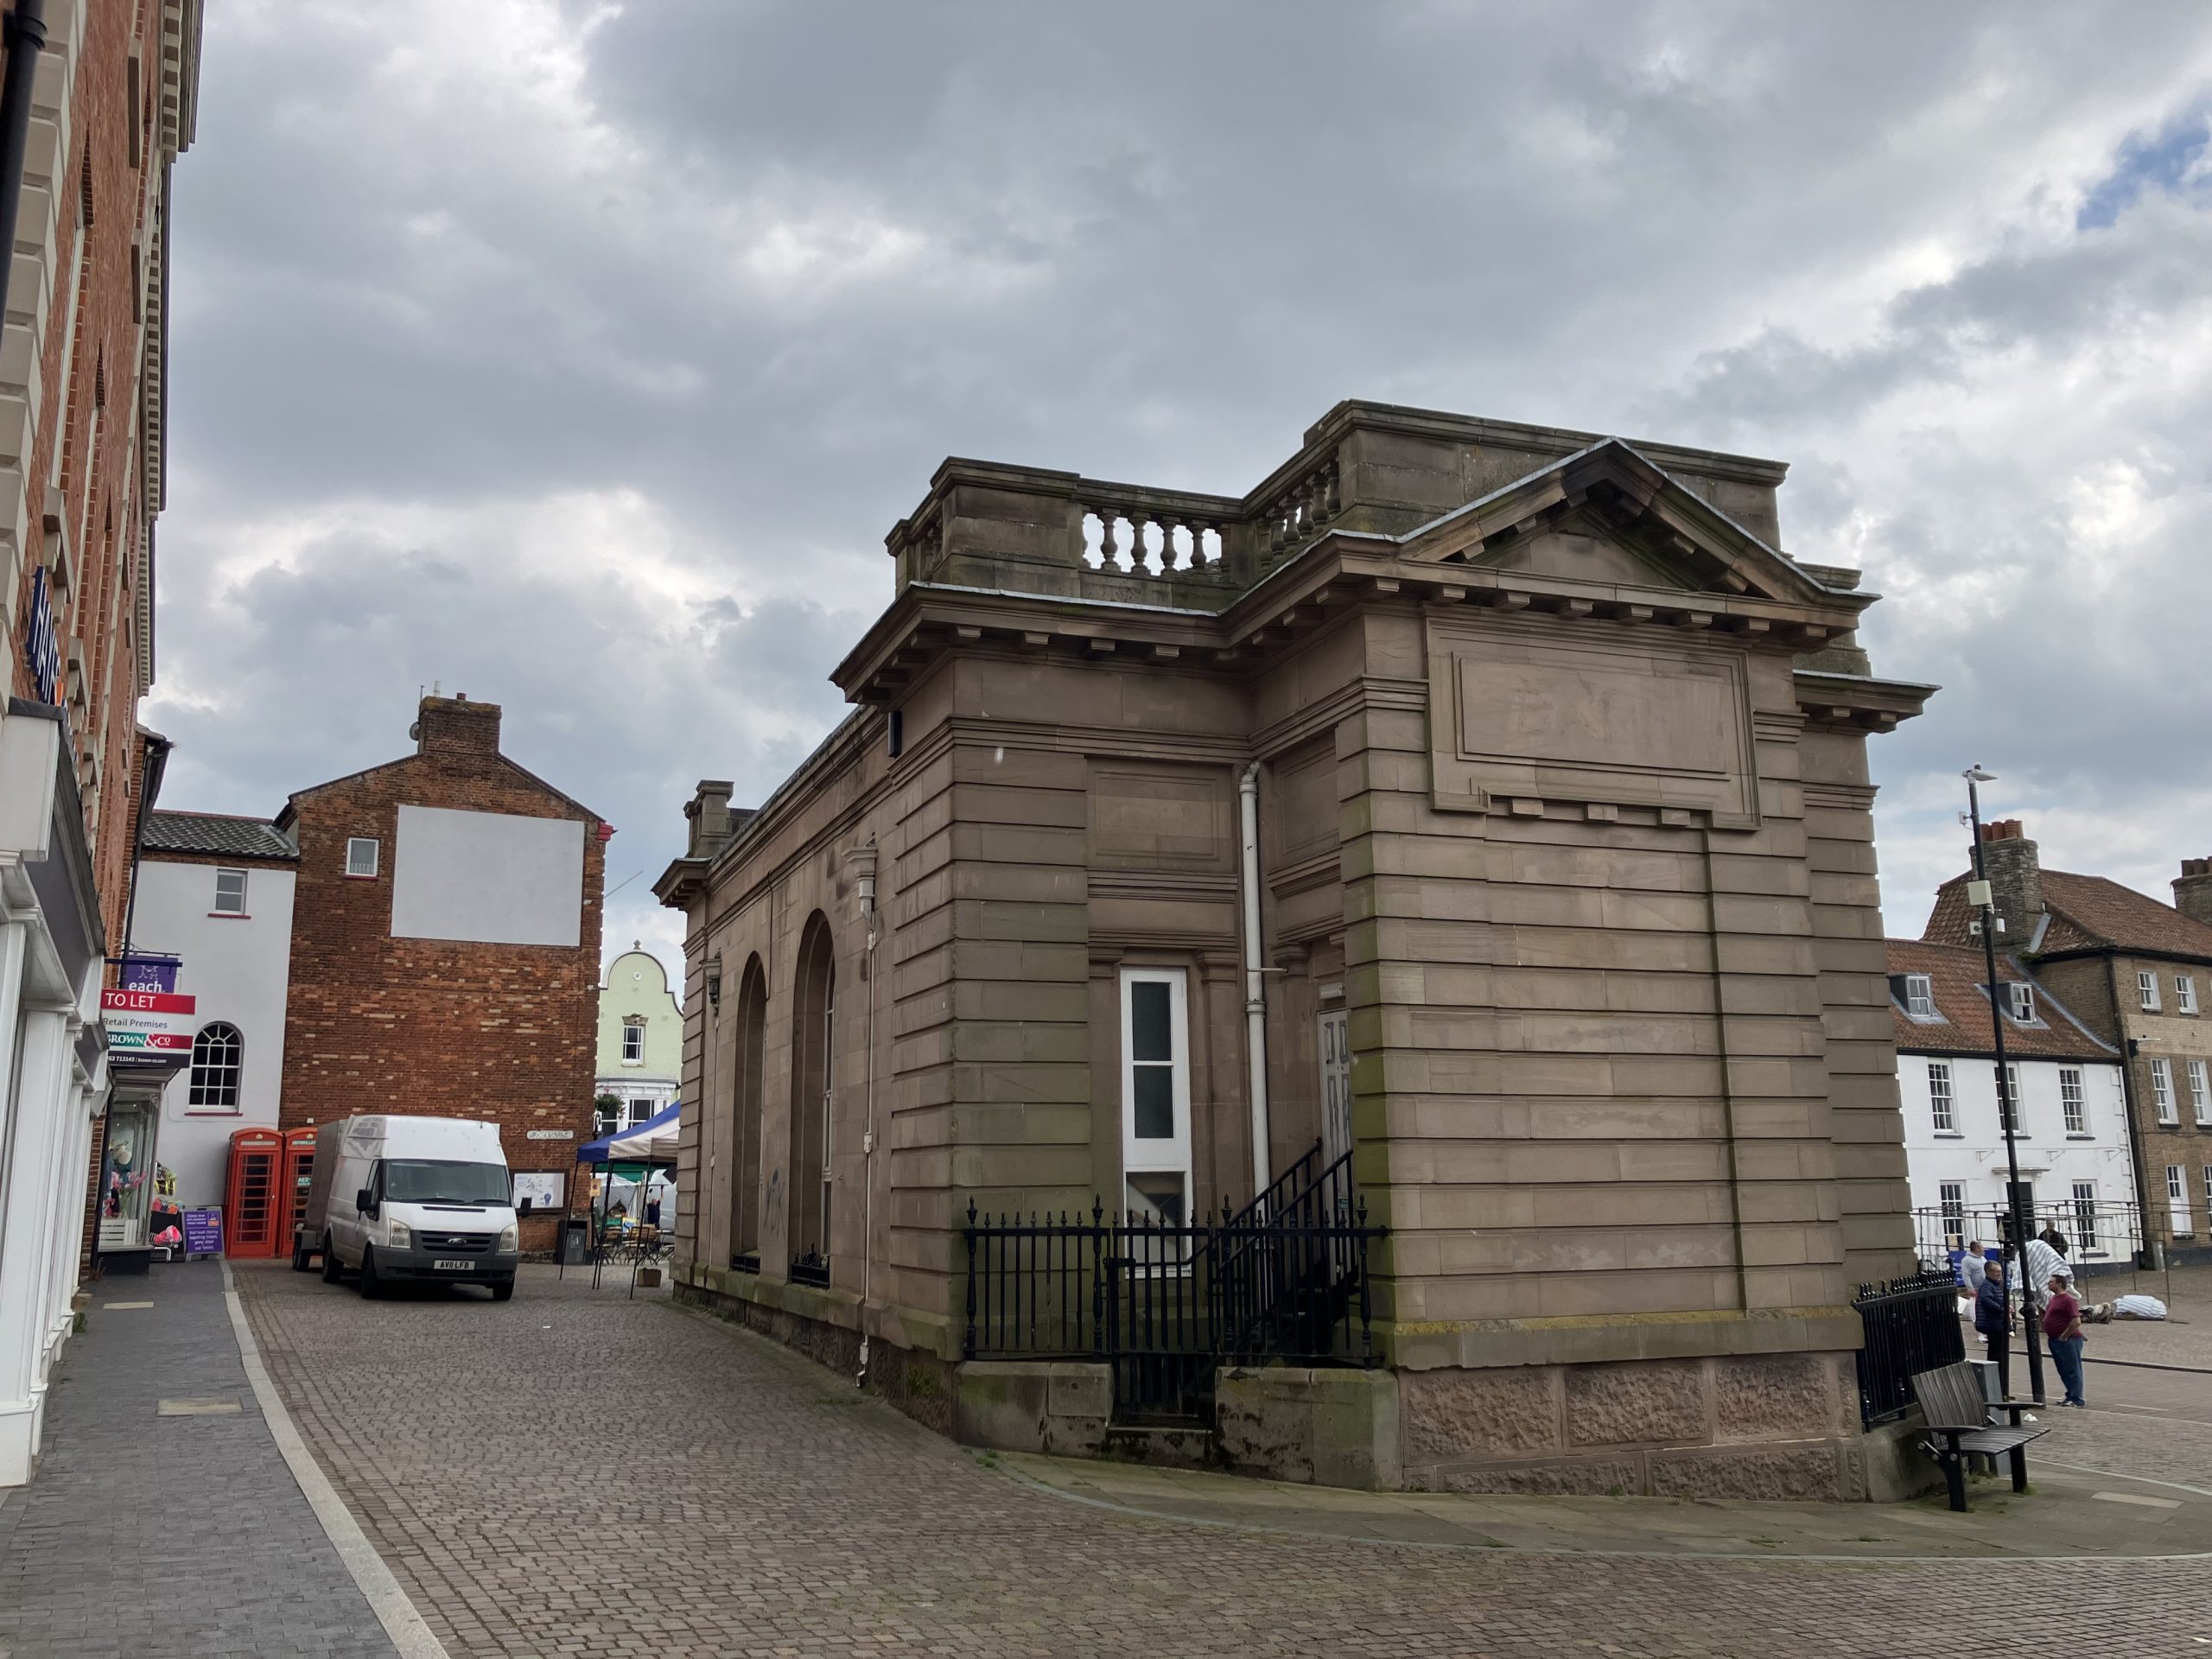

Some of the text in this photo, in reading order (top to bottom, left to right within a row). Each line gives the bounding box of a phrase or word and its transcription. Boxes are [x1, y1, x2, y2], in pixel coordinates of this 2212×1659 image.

[129, 981, 162, 993] each
[105, 993, 156, 1008] TO LET
[104, 1018, 168, 1028] Retail Premises
